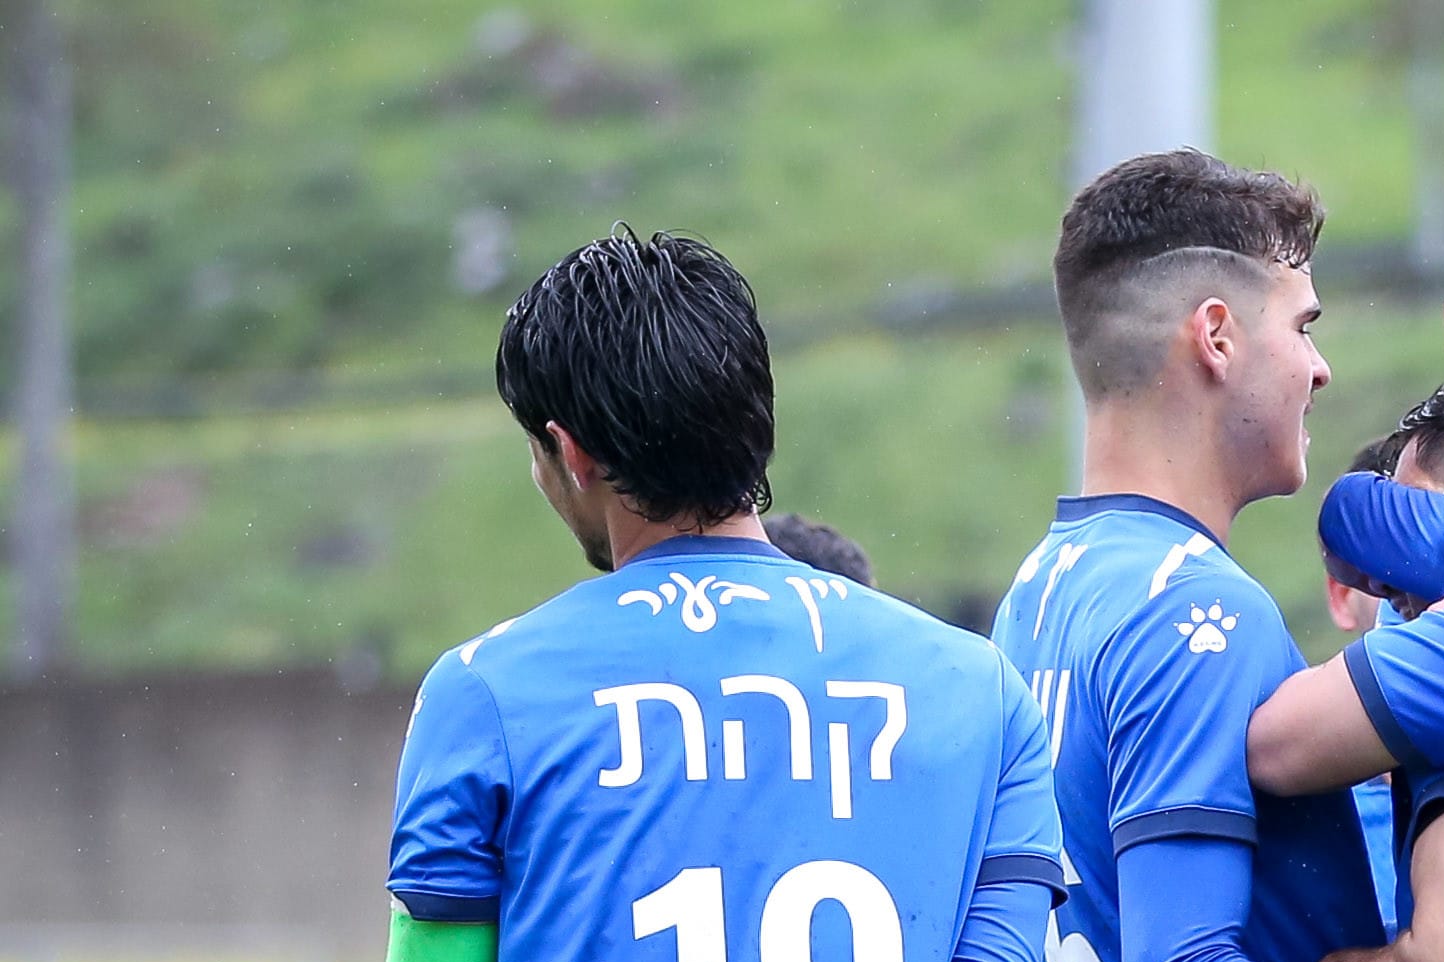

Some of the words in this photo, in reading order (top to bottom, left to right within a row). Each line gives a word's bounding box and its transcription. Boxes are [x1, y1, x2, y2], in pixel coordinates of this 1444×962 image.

[617, 571, 770, 632] בעיר
[784, 575, 848, 653] יין
[593, 674, 908, 819] קהת
